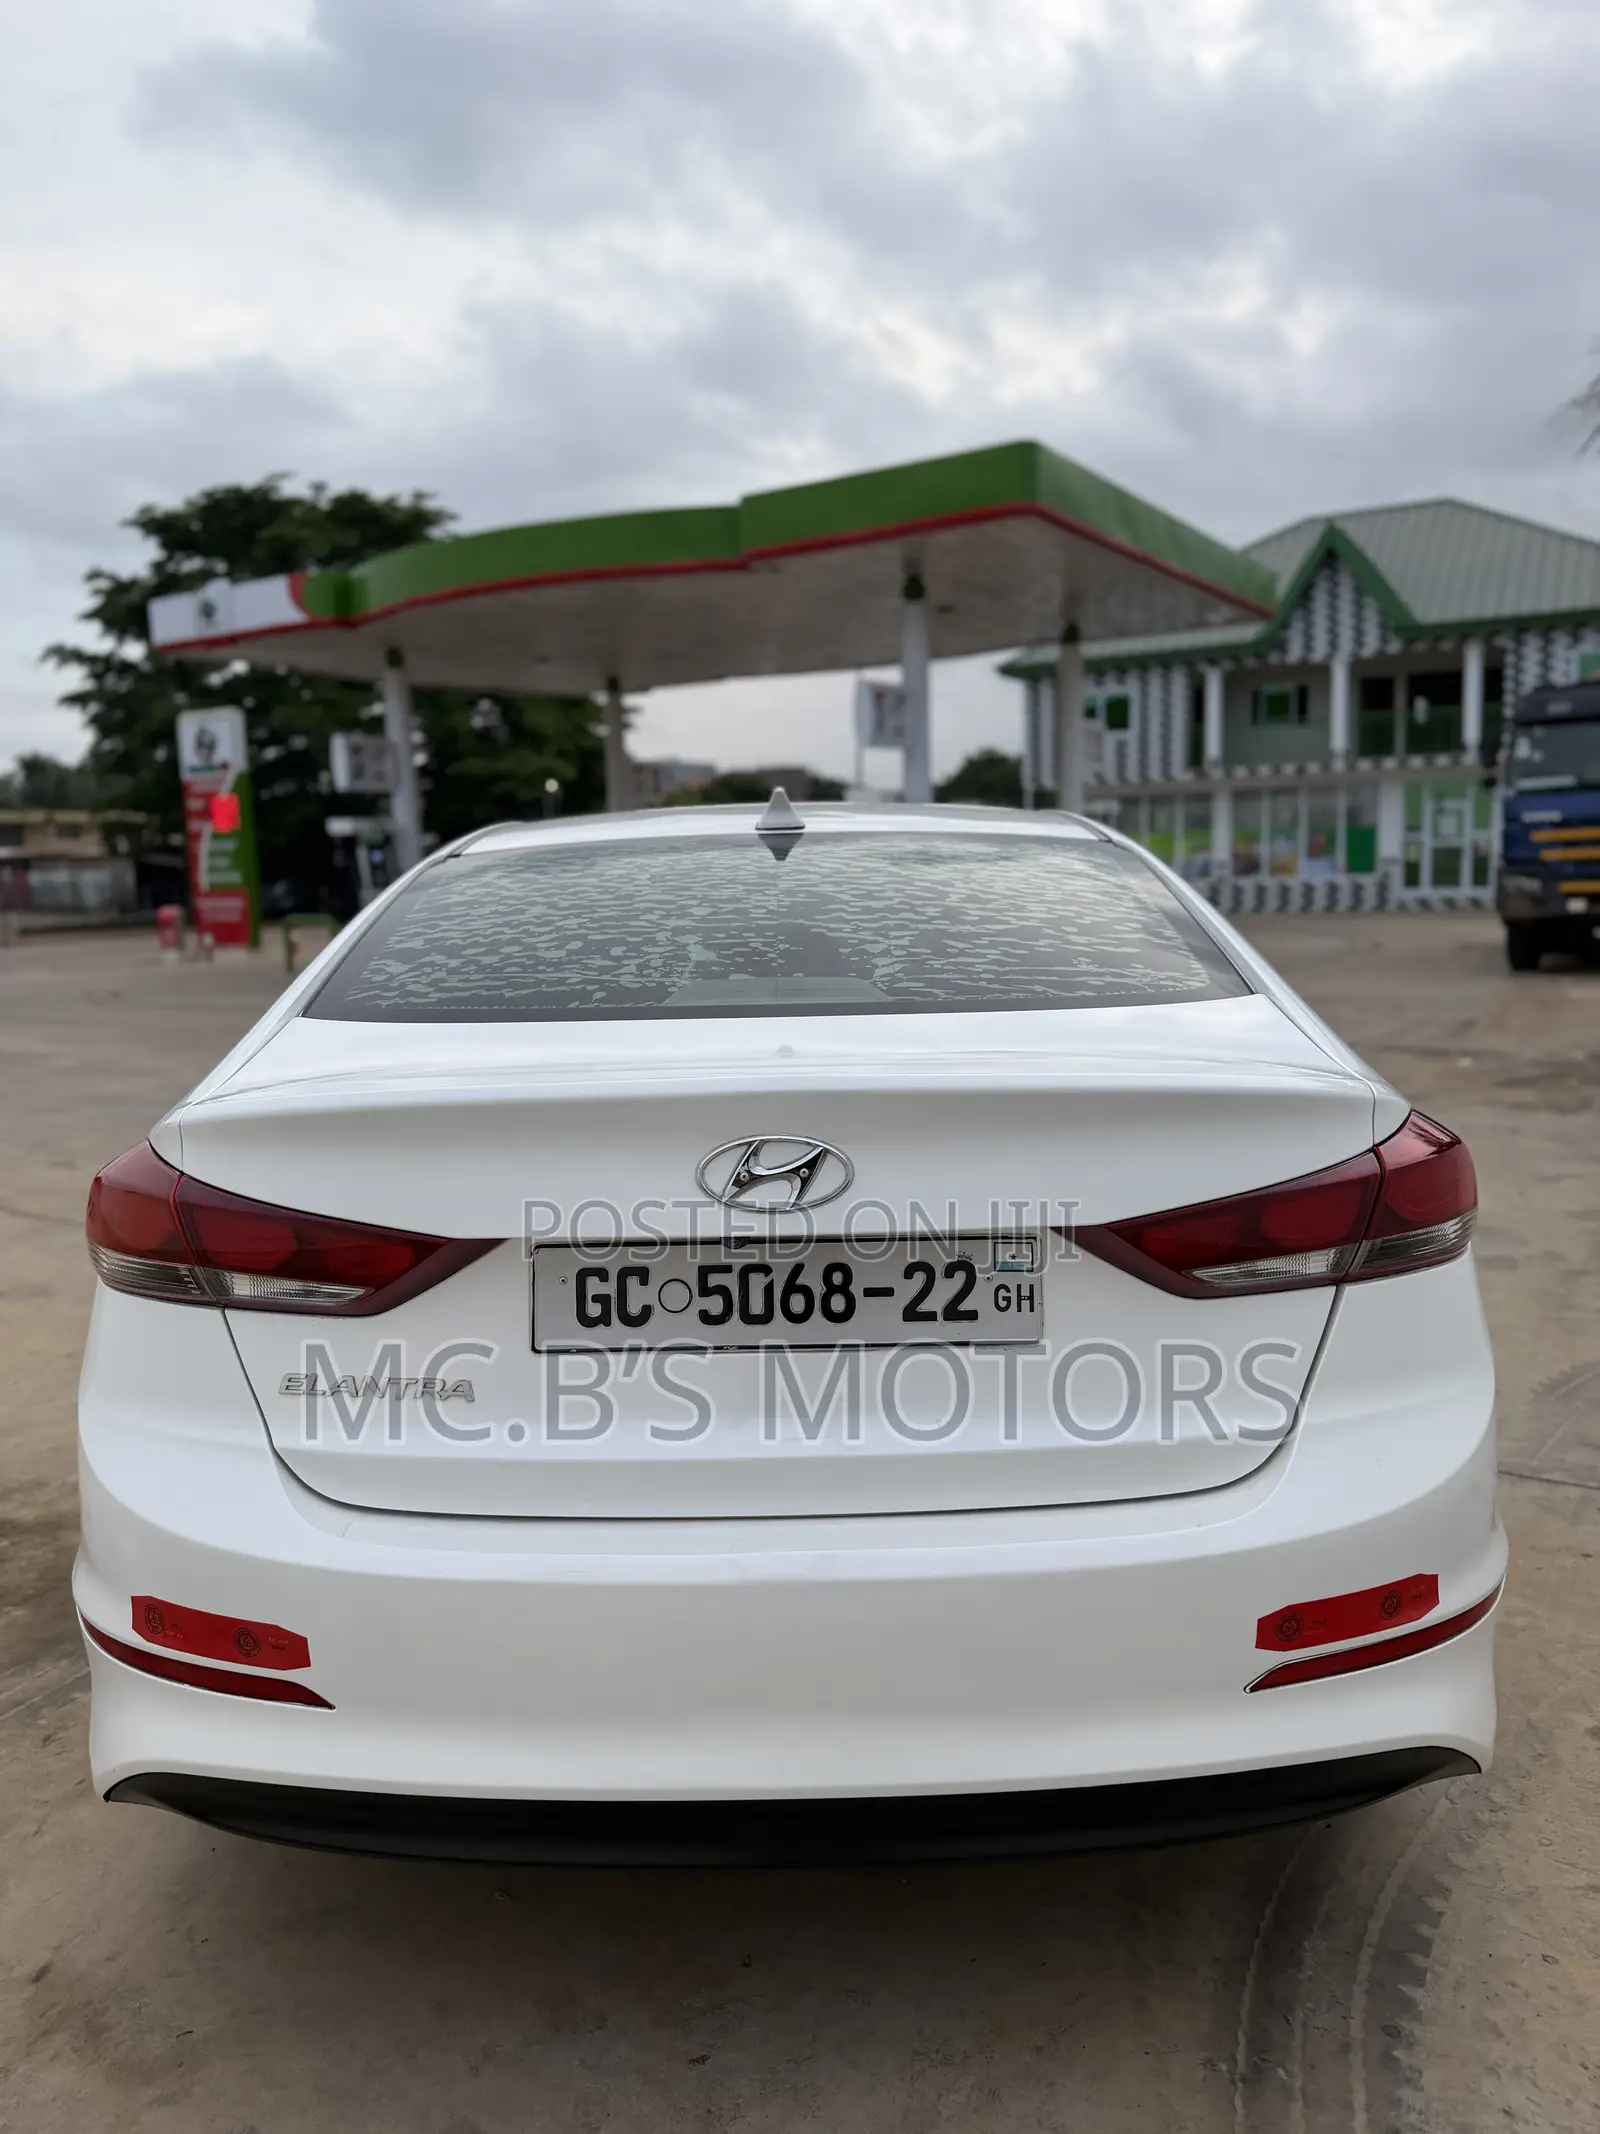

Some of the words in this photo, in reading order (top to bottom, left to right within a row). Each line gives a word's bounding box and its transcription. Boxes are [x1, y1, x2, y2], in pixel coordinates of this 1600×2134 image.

[575, 1265, 652, 1328] GC
[698, 1261, 980, 1326] 5068-22
[993, 1283, 1035, 1313] GH
[278, 1372, 476, 1403] ELANTRA
